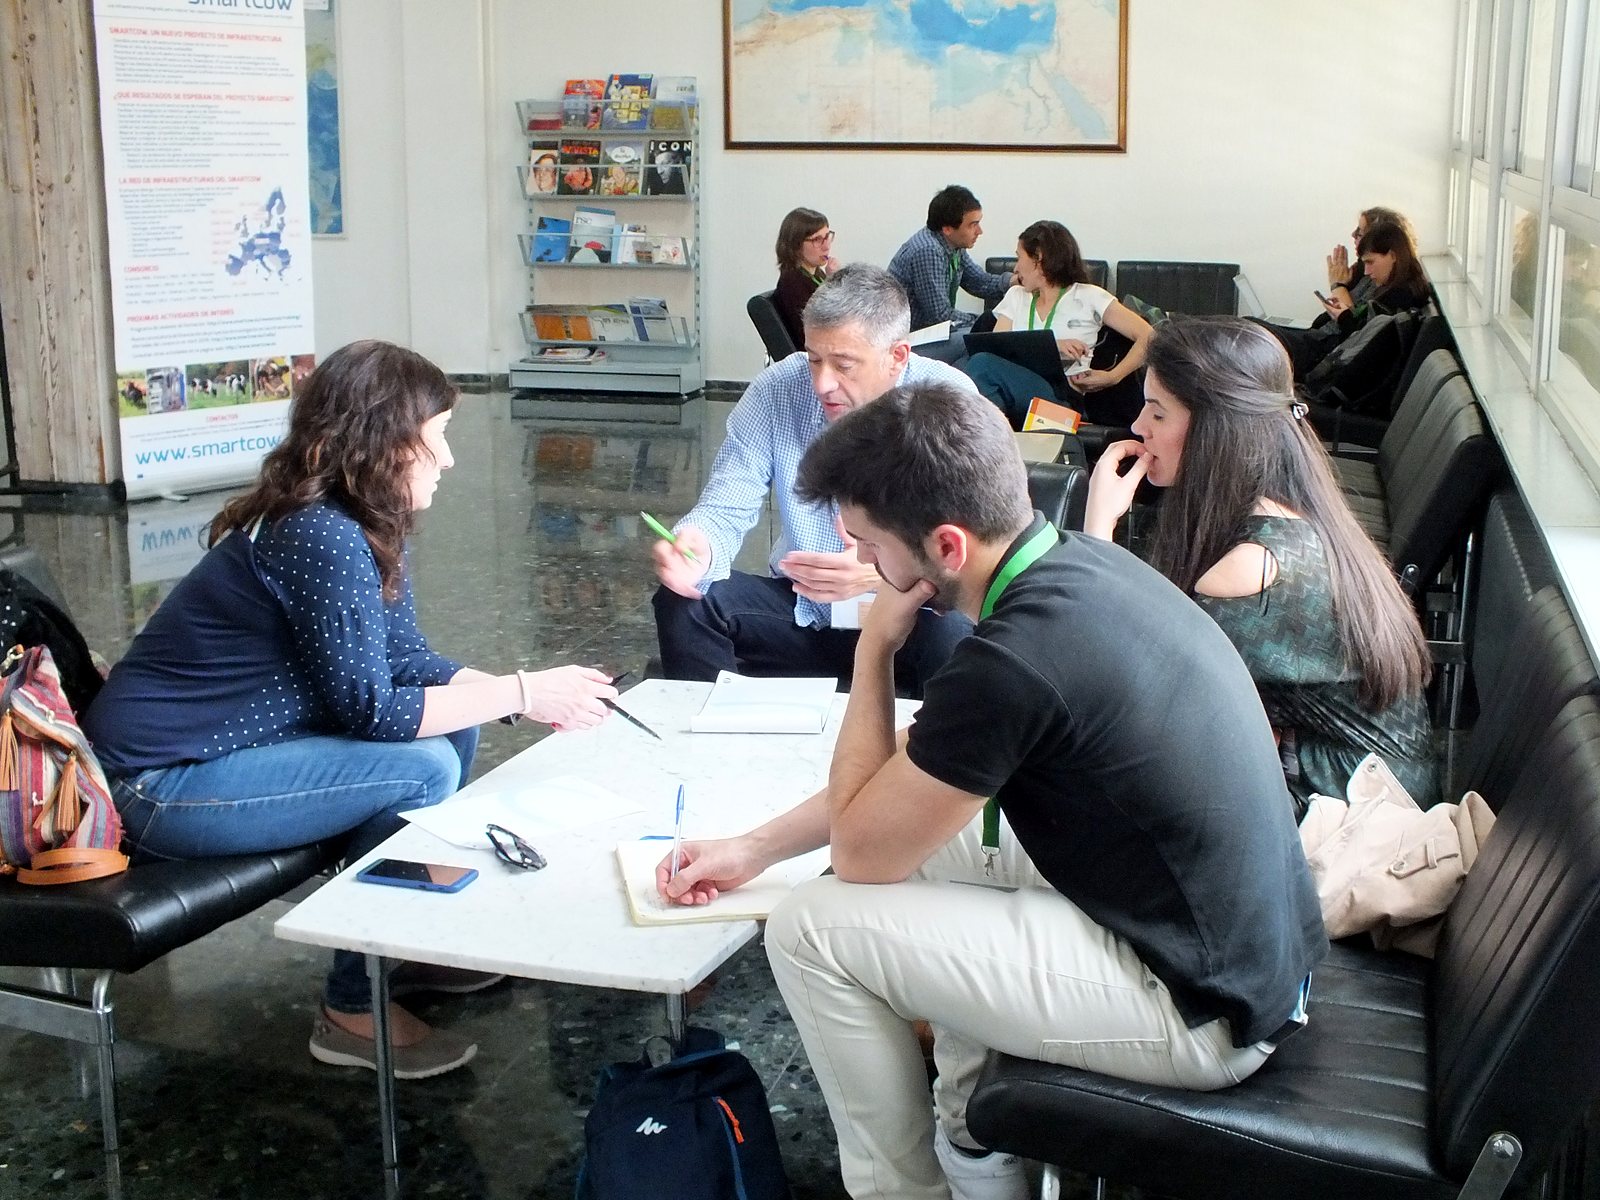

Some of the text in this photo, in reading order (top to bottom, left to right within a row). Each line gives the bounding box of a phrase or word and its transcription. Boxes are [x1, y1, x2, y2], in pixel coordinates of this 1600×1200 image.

[184, 31, 216, 39] PROYECTO
[649, 141, 693, 151] ICON
[160, 311, 199, 320] ACTIVIDADES
